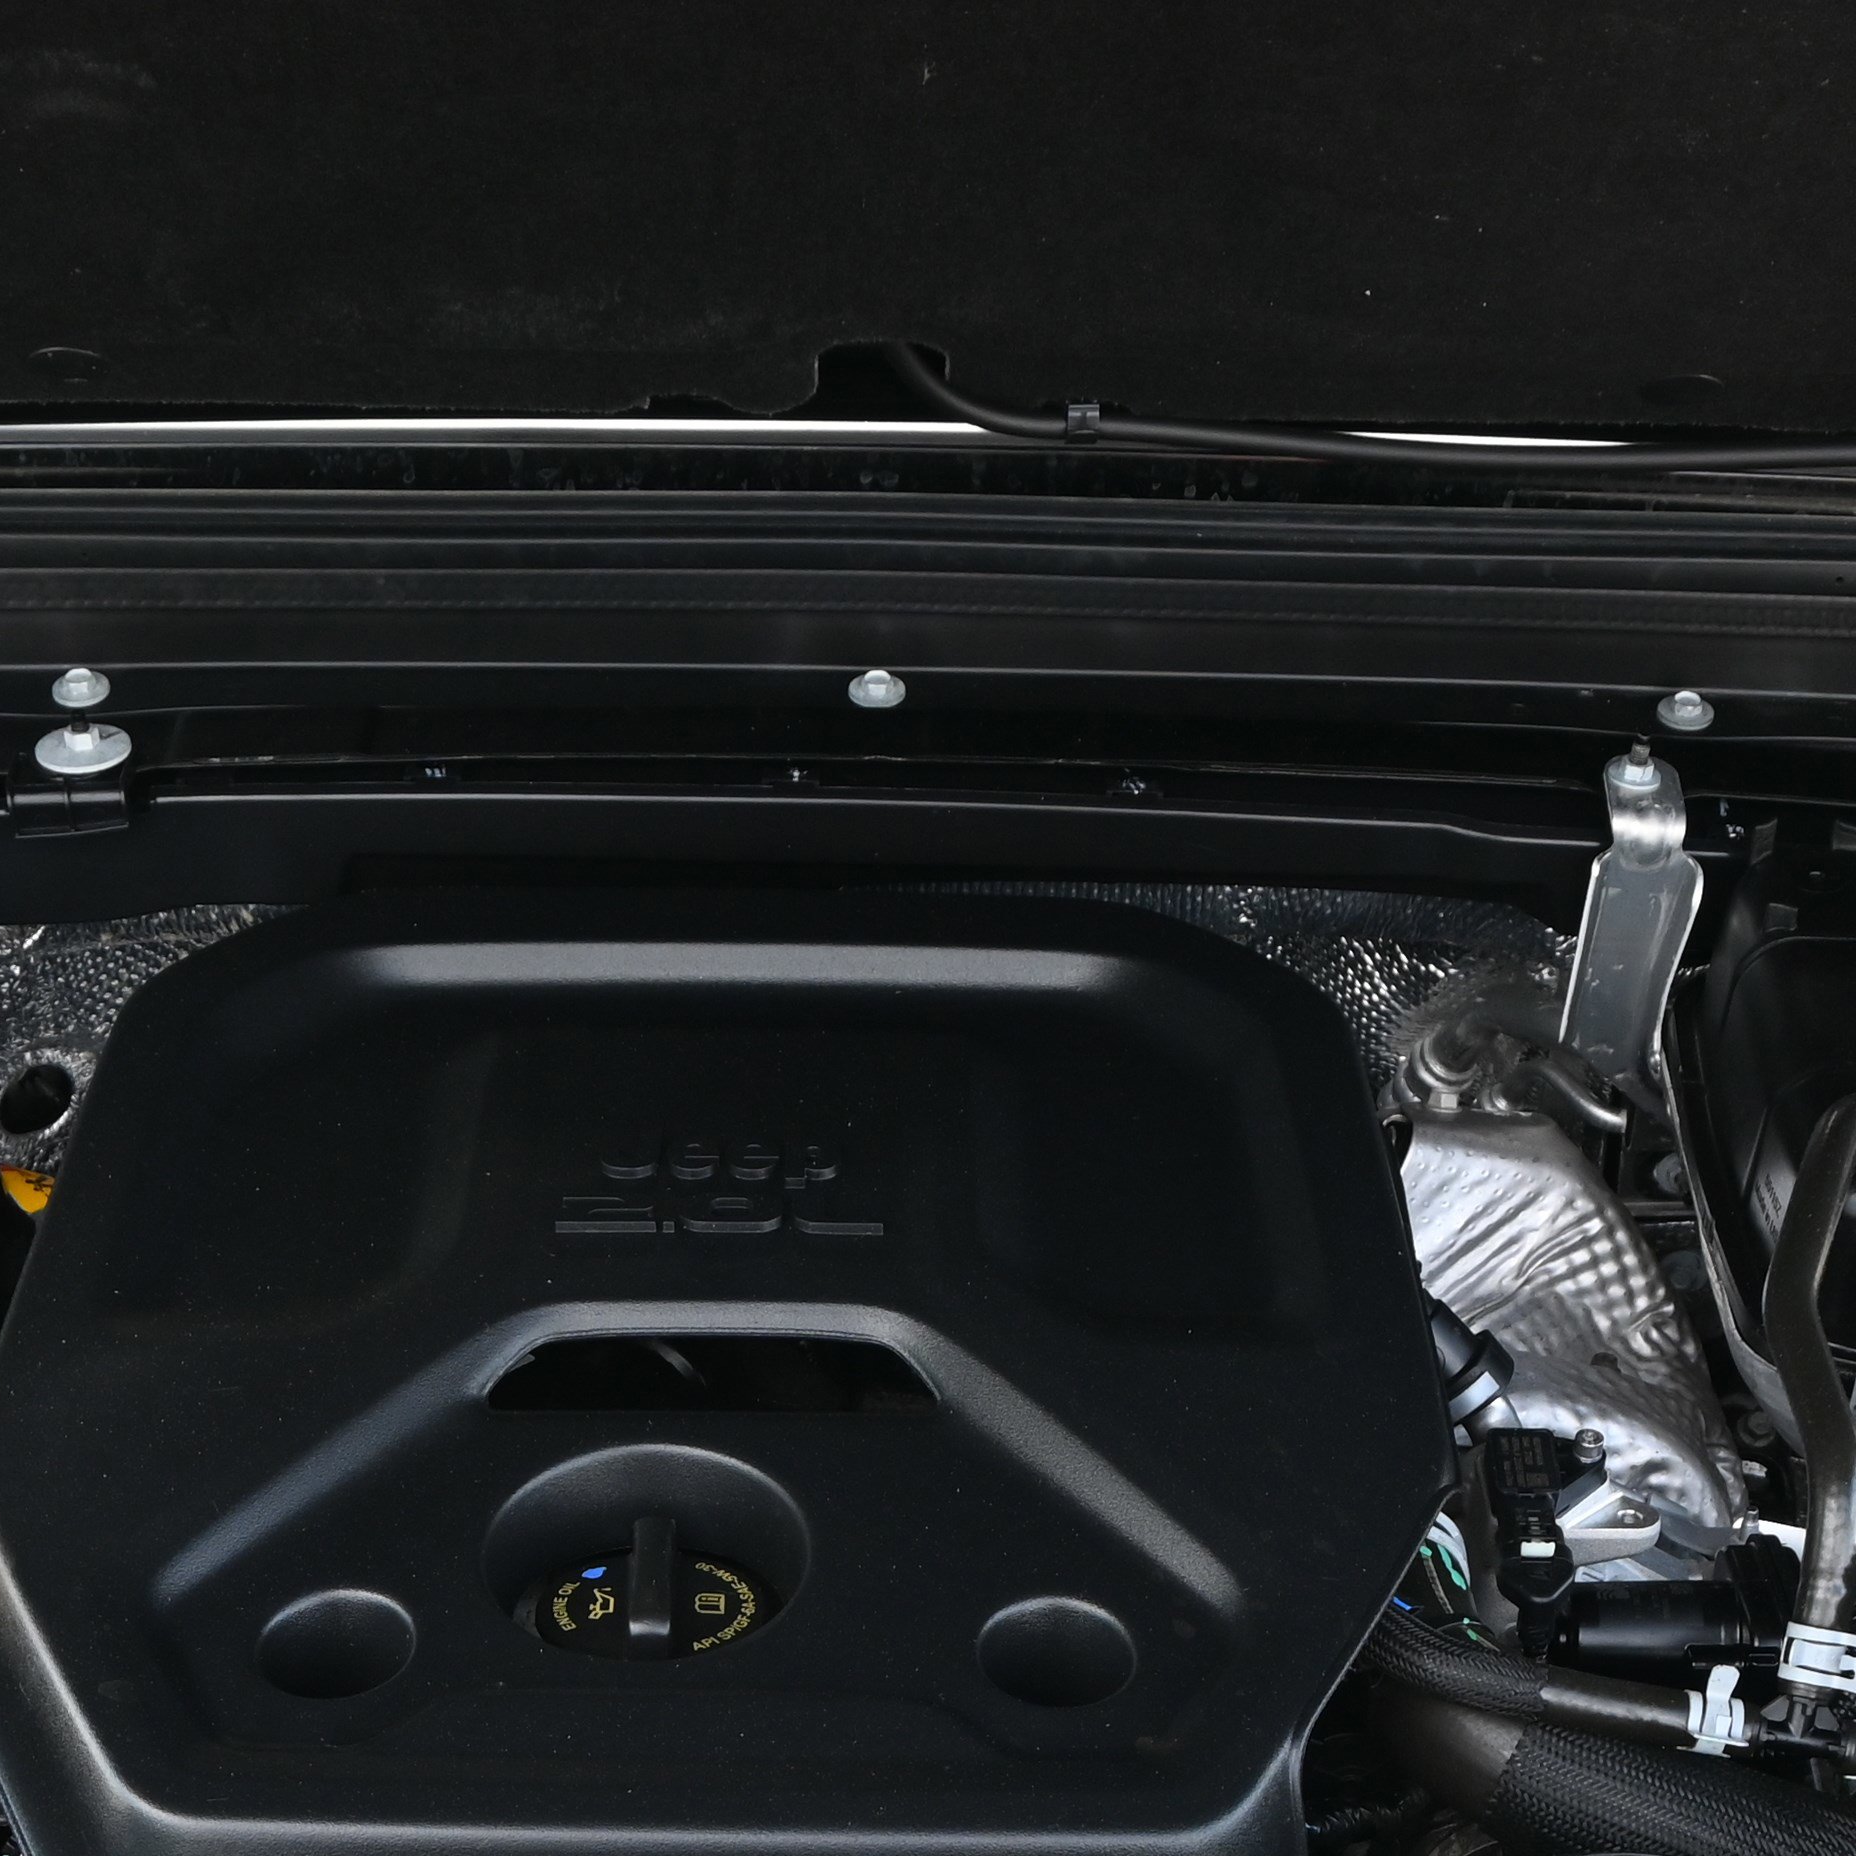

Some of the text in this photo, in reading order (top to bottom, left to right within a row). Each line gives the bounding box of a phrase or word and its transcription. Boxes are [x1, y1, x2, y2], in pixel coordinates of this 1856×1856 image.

[601, 1137, 841, 1189] Jeep
[552, 1581, 581, 1632] ENGINE OIL
[692, 1636, 720, 1651] API
